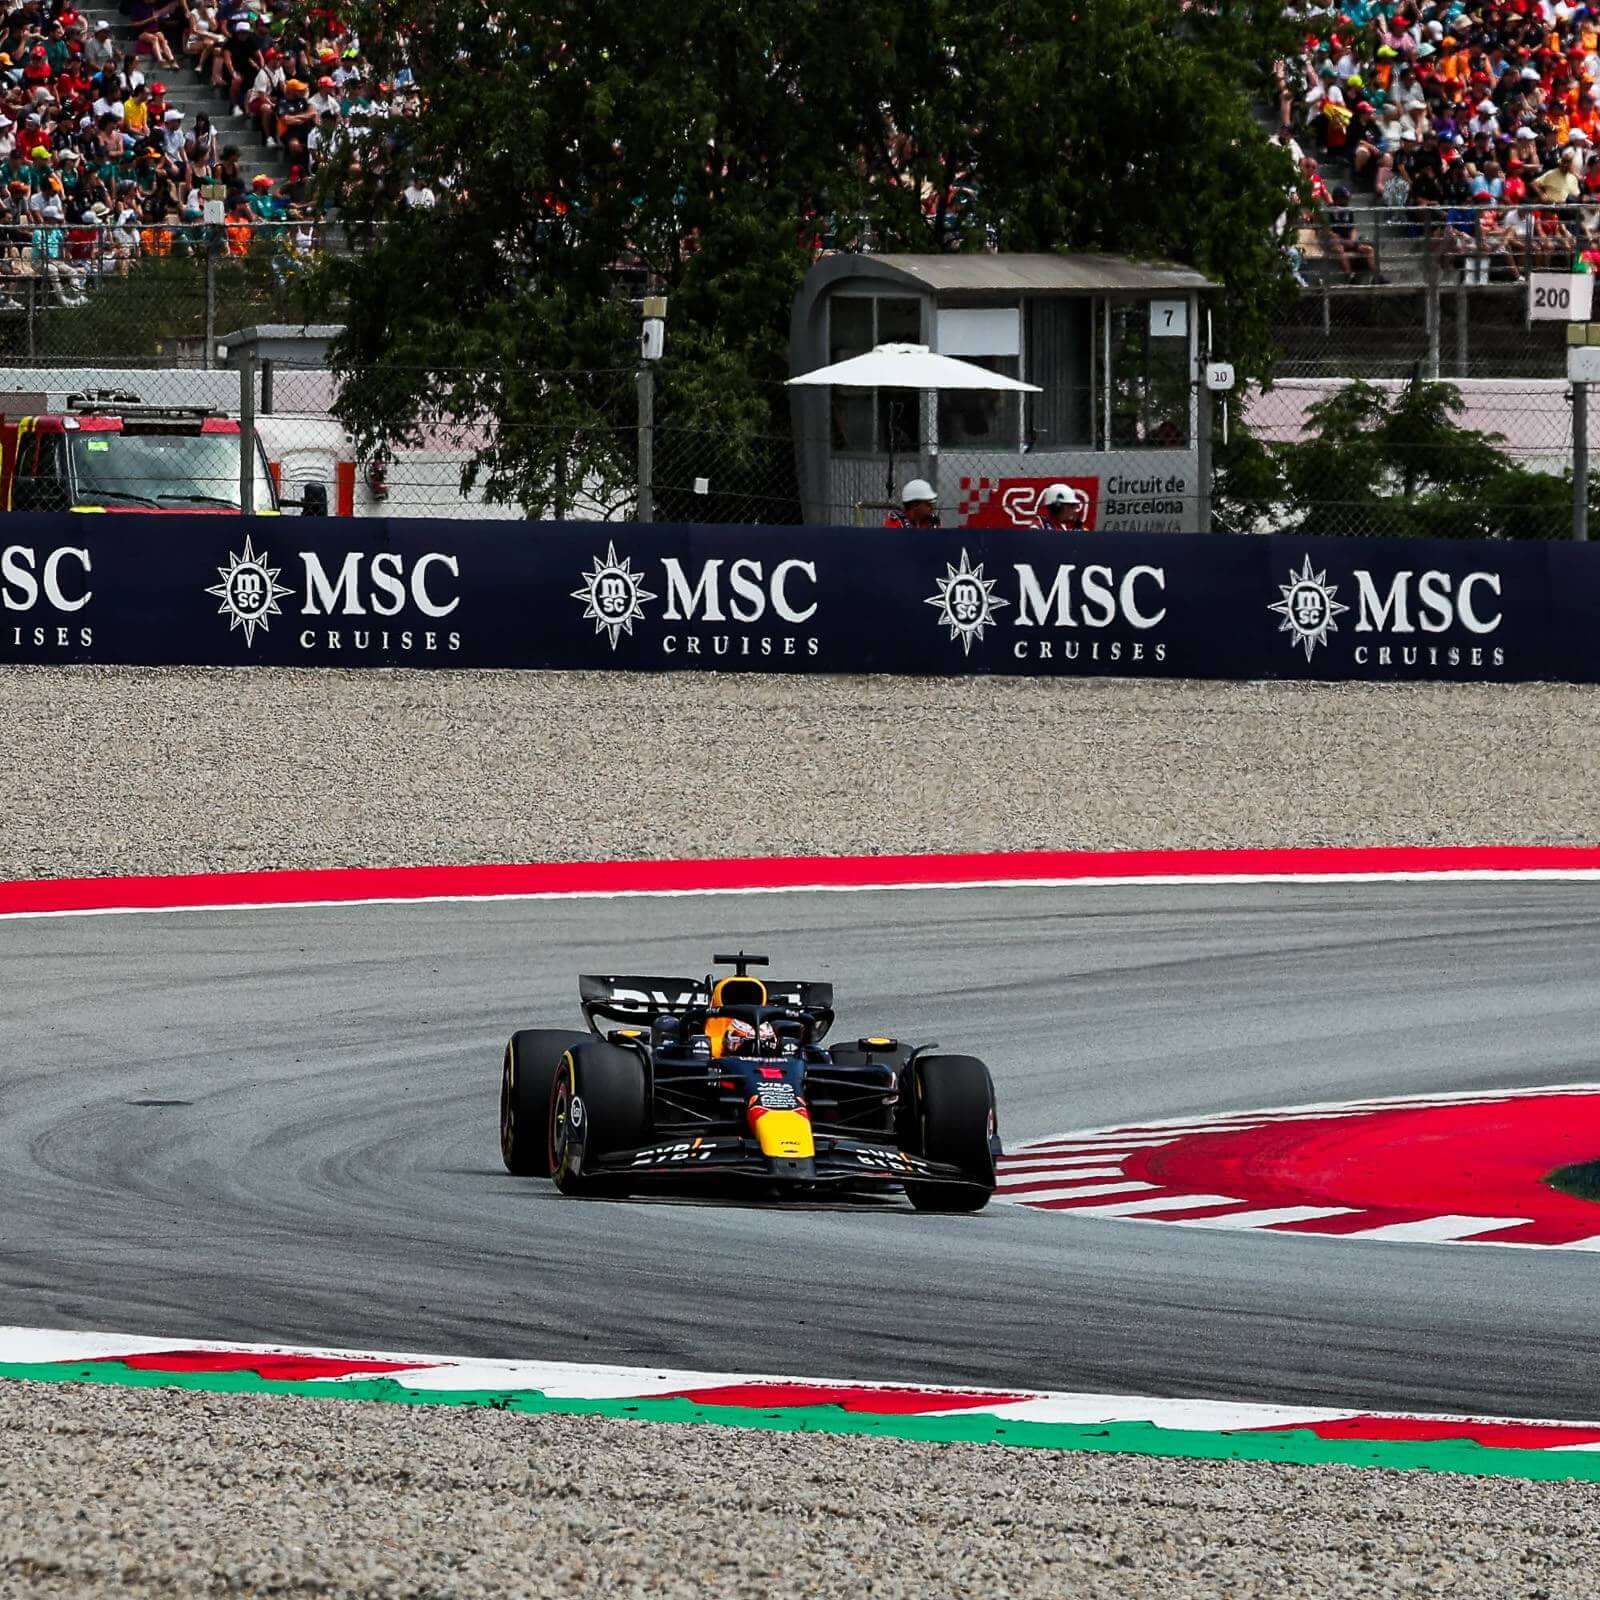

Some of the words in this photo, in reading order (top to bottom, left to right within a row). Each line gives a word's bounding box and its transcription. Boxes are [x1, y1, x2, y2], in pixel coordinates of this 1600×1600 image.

[1535, 286, 1570, 309] 200
[1164, 310, 1174, 327] 7
[1214, 371, 1228, 382] 10
[1107, 475, 1162, 495] Circuit
[1165, 475, 1186, 493] de
[1104, 498, 1184, 516] Barcelona
[299, 552, 459, 617] MSC
[661, 558, 817, 622] MSC
[1014, 564, 1166, 628] MSC
[1353, 571, 1502, 633] MSC
[300, 630, 459, 650] CRUISES
[663, 636, 818, 655] CRUISES
[1014, 641, 1165, 660] CRUISES
[1355, 647, 1503, 665] CRUISES
